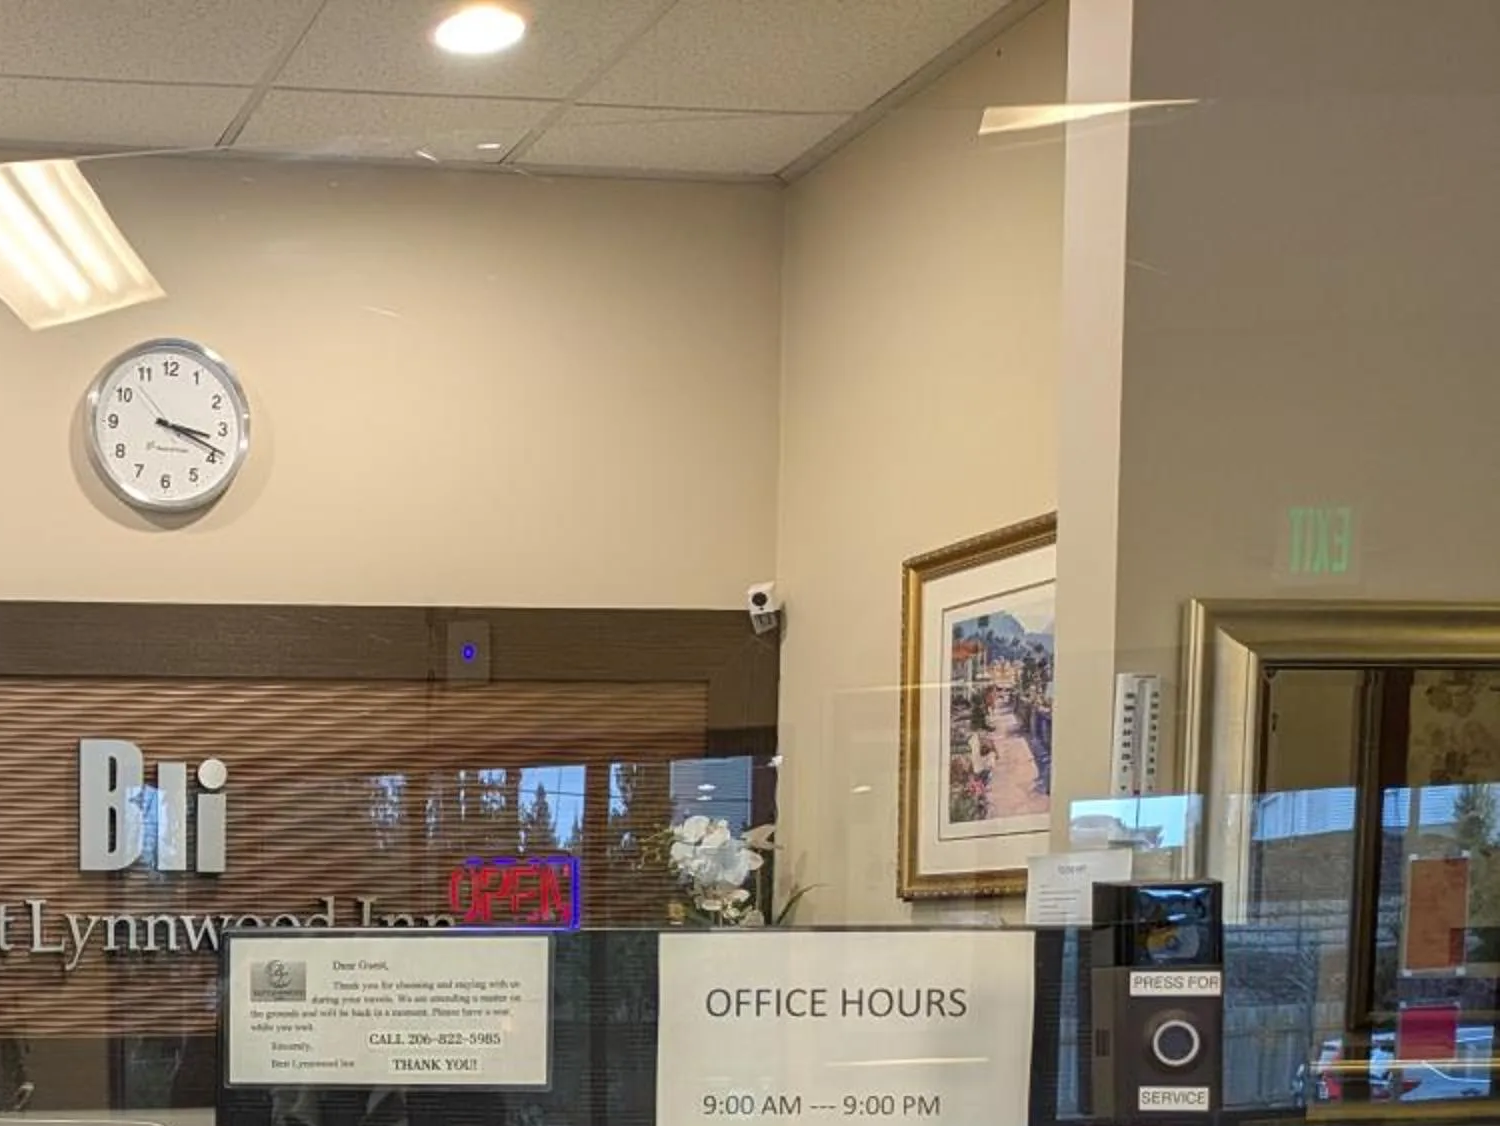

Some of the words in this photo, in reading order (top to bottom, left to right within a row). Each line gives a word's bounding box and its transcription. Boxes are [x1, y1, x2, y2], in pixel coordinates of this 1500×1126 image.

[138, 367, 152, 382] 11
[163, 361, 180, 377] 12
[193, 370, 200, 385] 1
[116, 387, 133, 403] 10
[211, 394, 222, 410] 2
[107, 413, 119, 429] 9
[217, 422, 228, 437] 3
[115, 443, 126, 459] 8
[206, 450, 216, 465] 4
[134, 463, 145, 478] 7
[189, 467, 199, 482] 5
[160, 474, 171, 489] 6
[450, 864, 572, 922] OPEN
[333, 961, 356, 971] Dear
[1133, 975, 1184, 990] PRESS
[1188, 976, 1220, 990] FOR
[705, 988, 827, 1019] OFFICE
[841, 988, 967, 1019] HOURS
[369, 1033, 404, 1045] CALL
[407, 1033, 501, 1045] 206-822-5985
[392, 1059, 441, 1071] THANK
[445, 1058, 478, 1071] YOU!
[702, 1095, 755, 1117] 9:00
[761, 1095, 802, 1117] AM
[843, 1095, 895, 1117] 9:00
[902, 1095, 941, 1117] PM
[1141, 1091, 1206, 1106] SERVICE
